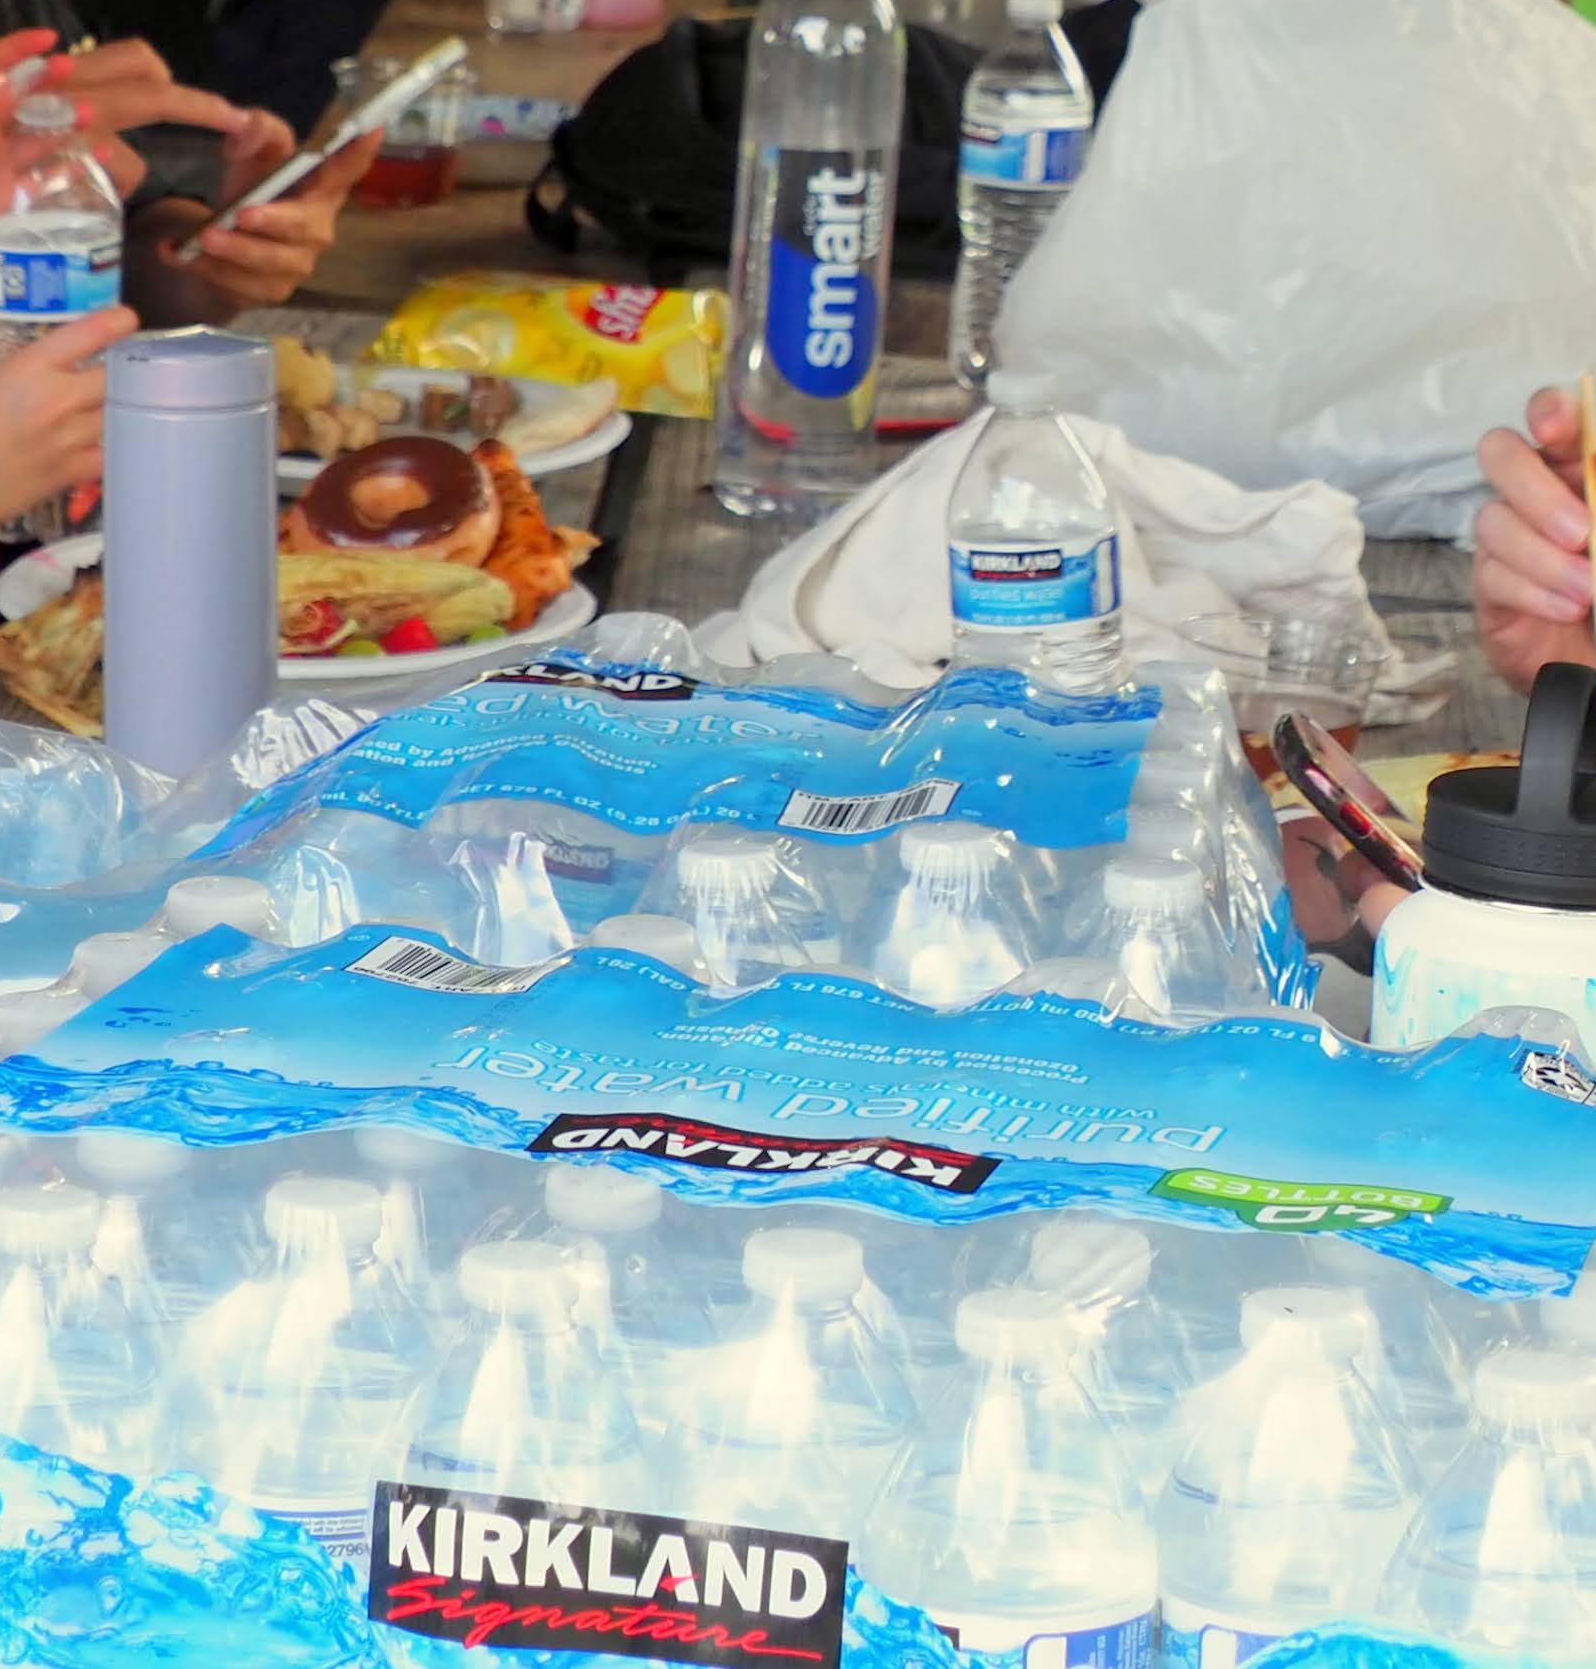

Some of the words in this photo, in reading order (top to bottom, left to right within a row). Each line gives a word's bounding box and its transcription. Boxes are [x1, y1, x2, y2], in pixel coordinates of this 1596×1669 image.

[804, 168, 867, 369] smart
[543, 786, 568, 800] FL
[573, 795, 602, 811] OZ
[637, 966, 687, 991] GAL)
[792, 981, 817, 992] FL
[820, 985, 864, 999] 676
[866, 995, 916, 1012] NET
[788, 1032, 889, 1054] Reverse
[1227, 1025, 1260, 1037] OZ
[1268, 1028, 1295, 1039] FL
[529, 1040, 637, 1068] taste
[784, 1041, 911, 1066] Advanced
[896, 1047, 946, 1058] and
[916, 1057, 948, 1067] by
[953, 1051, 1078, 1073] Ozonation
[433, 1046, 743, 1103] water
[649, 1058, 705, 1078] for
[718, 1066, 852, 1092] added
[954, 1060, 1088, 1084] Processed
[861, 1082, 1047, 1112] minerals
[771, 1092, 1225, 1153] purified
[1057, 1103, 1155, 1120] with
[550, 1127, 963, 1186] KIRKLAND
[1187, 1174, 1424, 1209] BOTTLES
[1254, 1204, 1395, 1224] 40
[387, 1500, 828, 1619] KIRKLAND
[387, 1576, 824, 1661] Signature
